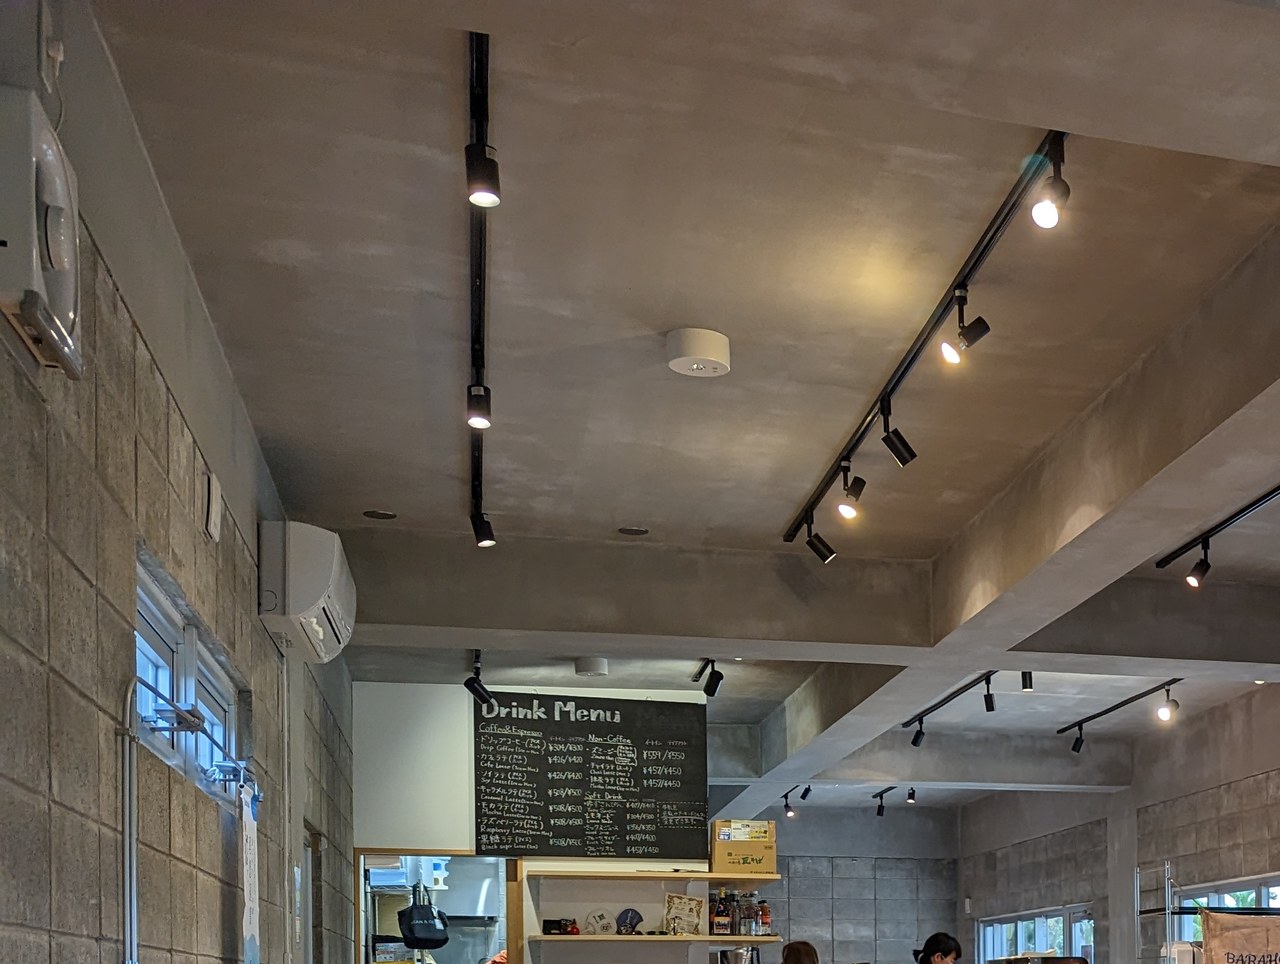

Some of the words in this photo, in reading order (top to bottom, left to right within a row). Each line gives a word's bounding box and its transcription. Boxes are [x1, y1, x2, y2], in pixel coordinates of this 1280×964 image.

[481, 698, 548, 719] Drink
[554, 700, 621, 723] Menu
[588, 733, 632, 744] Non-Coffee
